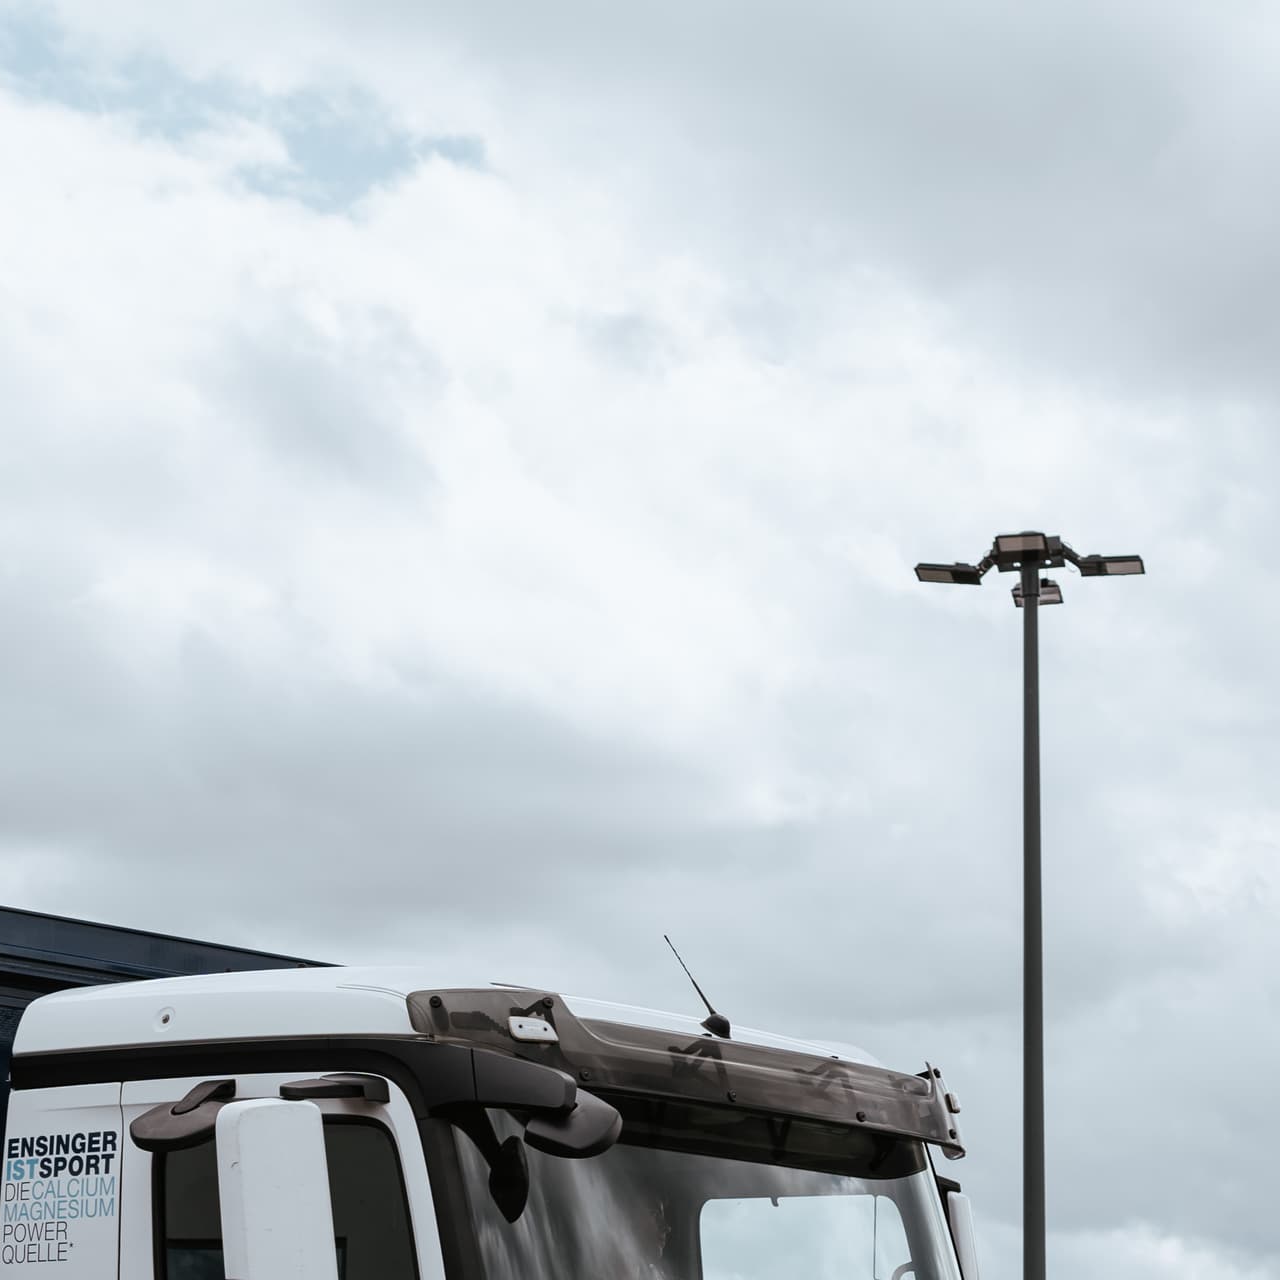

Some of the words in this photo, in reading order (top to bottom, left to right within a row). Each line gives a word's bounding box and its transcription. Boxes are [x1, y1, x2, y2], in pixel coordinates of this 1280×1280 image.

[7, 1131, 117, 1159] ENSINGER
[4, 1197, 115, 1222] MAGNESIUM
[3, 1221, 68, 1243] POWER
